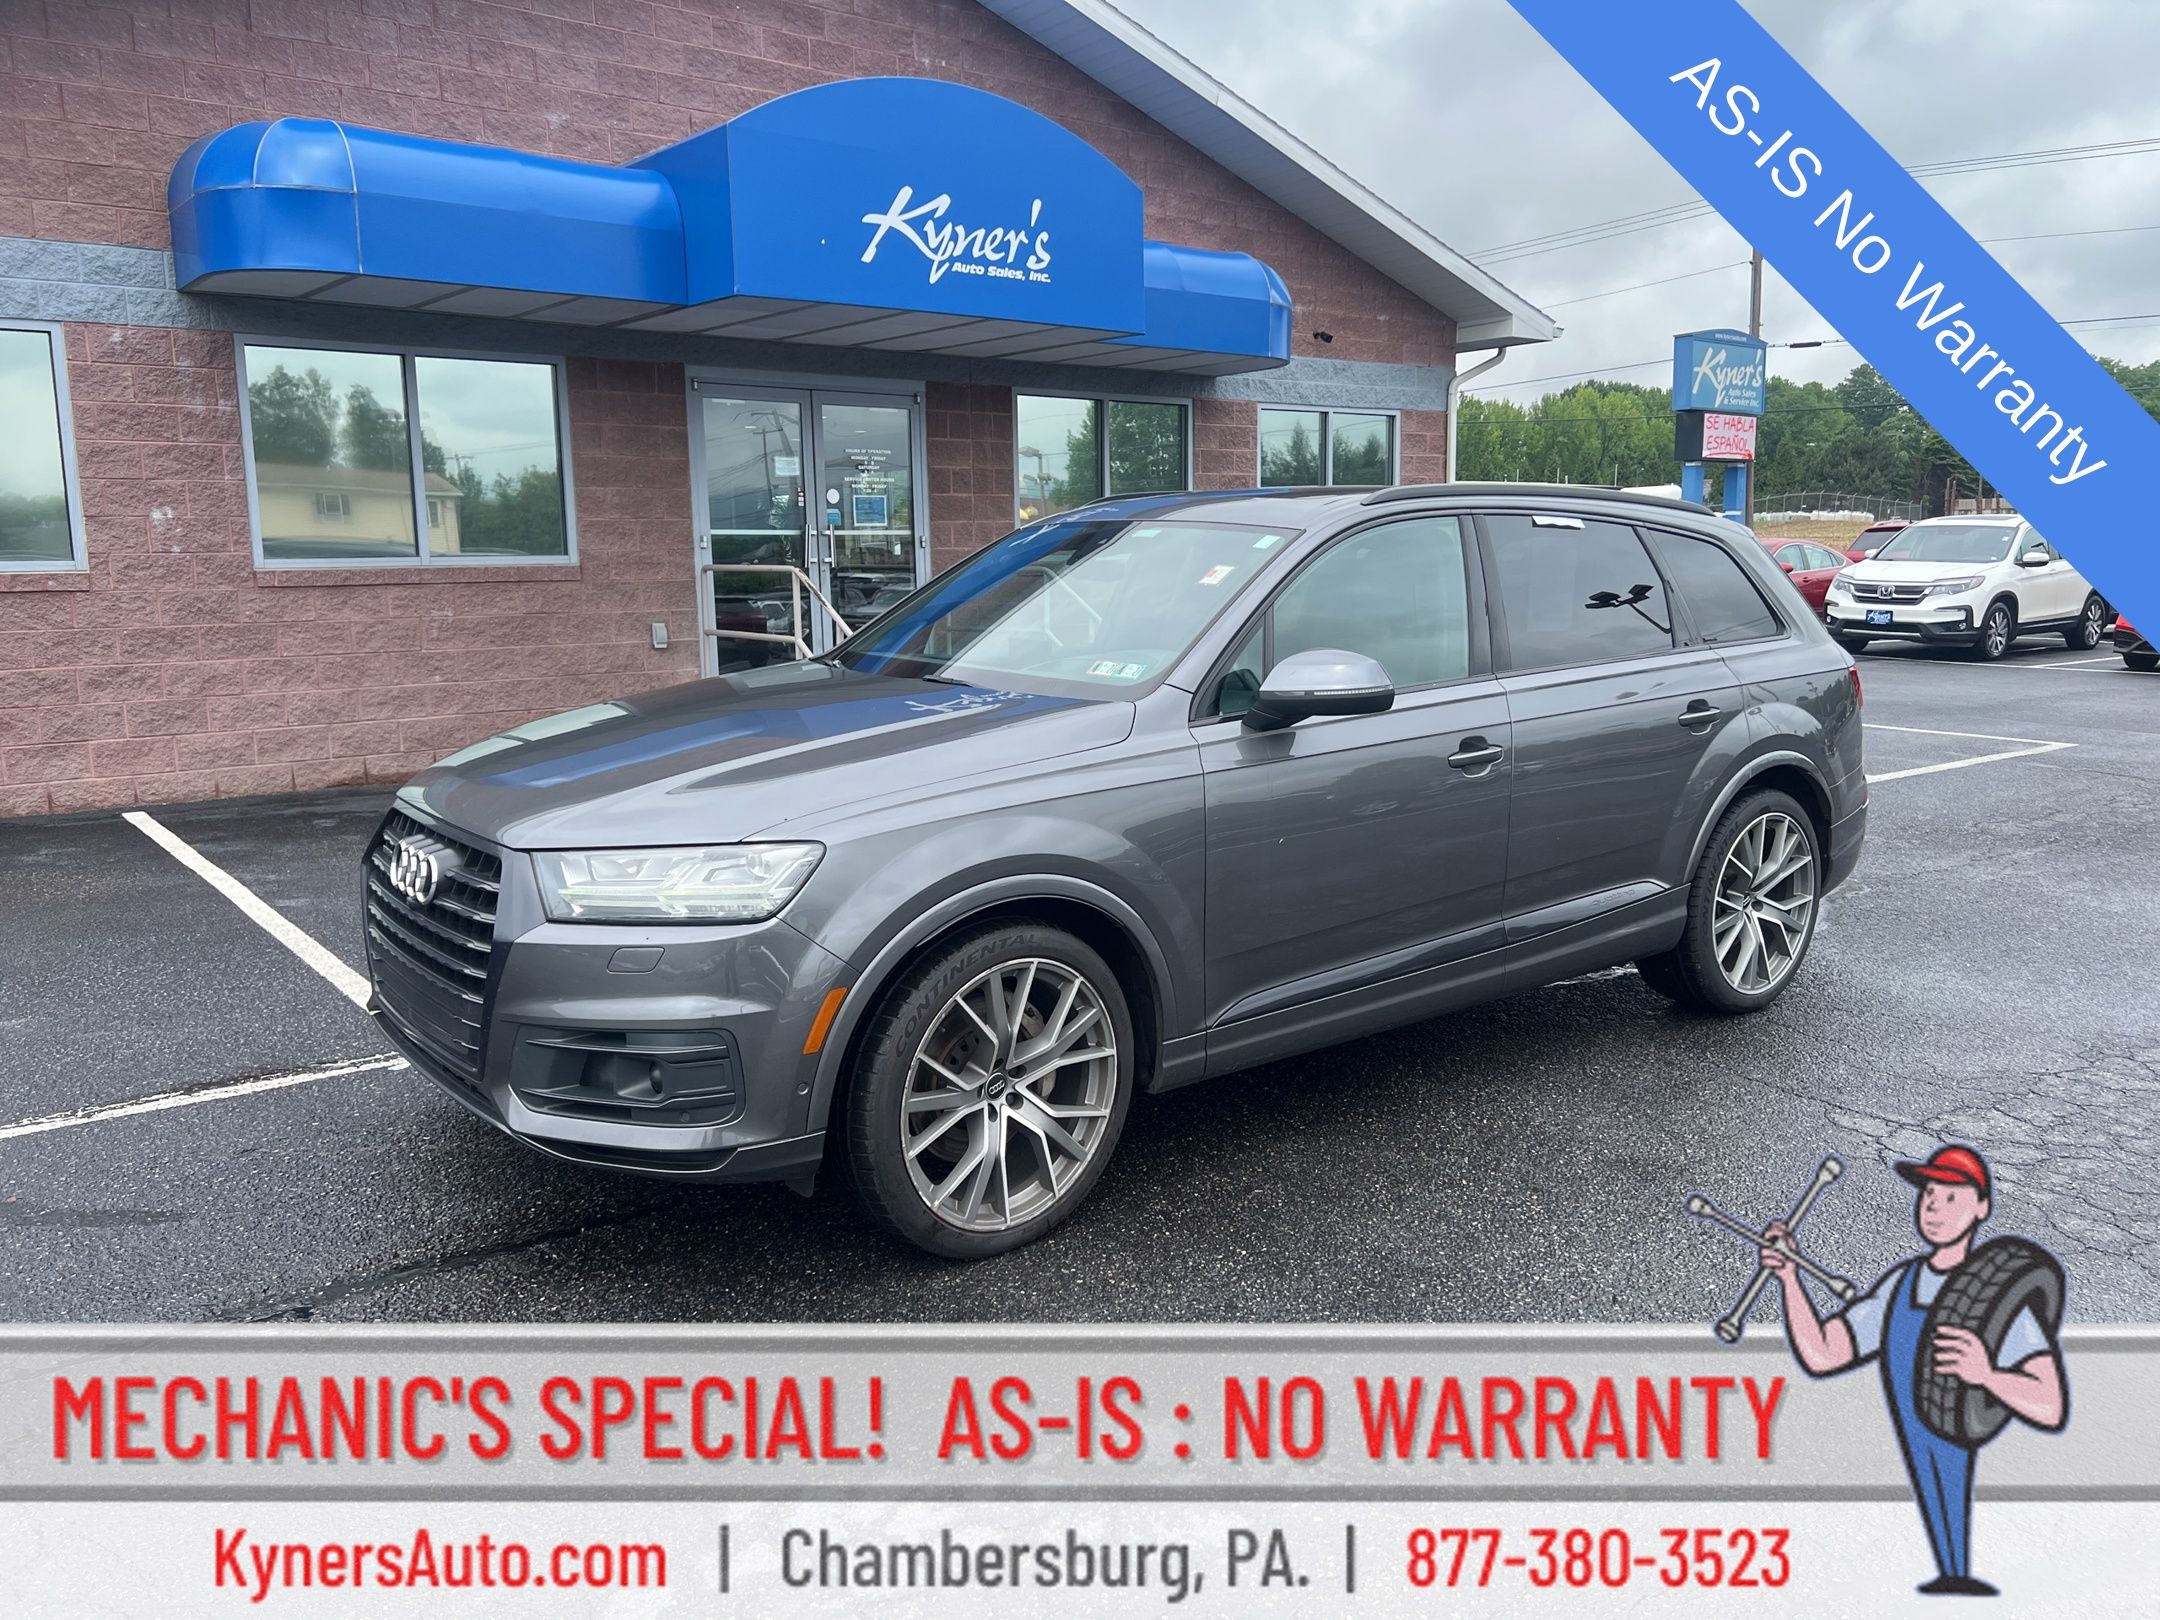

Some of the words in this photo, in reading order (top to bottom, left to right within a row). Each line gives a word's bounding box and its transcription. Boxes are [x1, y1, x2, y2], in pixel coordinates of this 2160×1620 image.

[861, 185, 1051, 284] Kyner's
[952, 262, 984, 275] Auto
[987, 266, 1026, 281] Sales,
[1029, 270, 1051, 283] Inc.
[1693, 346, 1763, 408] Kyner's
[1728, 388, 1741, 397] Auto
[1742, 388, 1756, 398] Sales
[1706, 416, 1719, 430] SE
[1724, 417, 1754, 432] HABLA
[896, 934, 1040, 1058] CONTINENTAL
